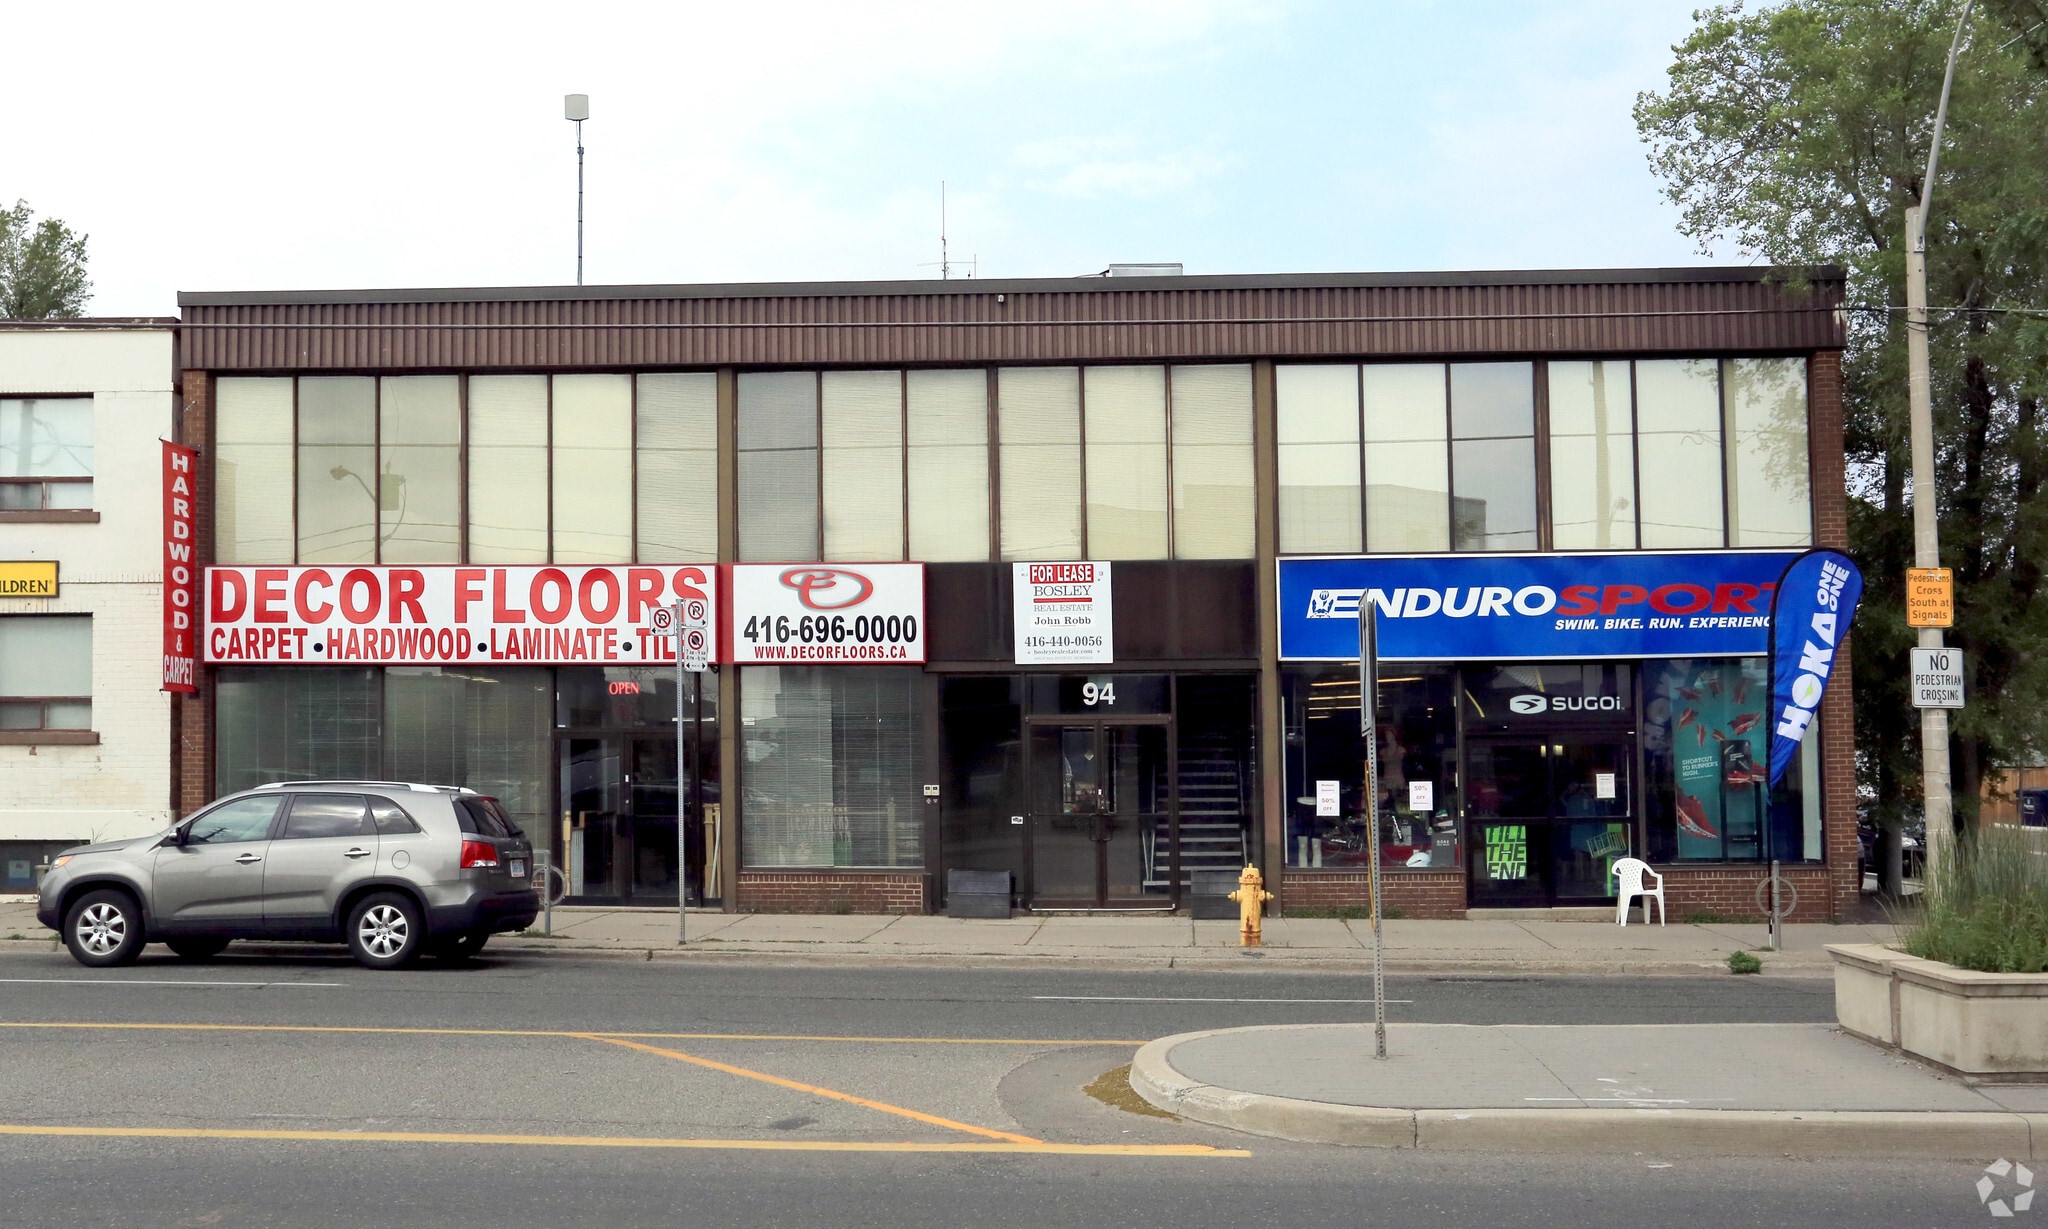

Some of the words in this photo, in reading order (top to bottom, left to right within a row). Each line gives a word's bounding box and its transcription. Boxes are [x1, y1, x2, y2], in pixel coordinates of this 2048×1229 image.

[168, 452, 190, 629] HARDWOOD
[1031, 565, 1053, 582] FOR
[1057, 565, 1092, 582] LEASE
[1909, 574, 1950, 583] Pedestrians
[1817, 560, 1838, 605] ONE
[1829, 566, 1850, 611] ONE
[210, 568, 427, 624] DECOR
[454, 567, 707, 624] FLOORS
[1033, 585, 1092, 597] BOSLEY
[1916, 586, 1942, 595] Cross
[1034, 604, 1058, 612] REAL
[1060, 603, 1093, 612] ESTATE
[1910, 598, 1937, 607] South
[1940, 599, 1950, 607] at
[1034, 617, 1060, 625] John
[1064, 616, 1091, 625] Robb
[1912, 610, 1948, 621] Signals
[744, 615, 917, 643] 416-696-0000
[1555, 619, 1599, 630] SWIM.
[1604, 618, 1643, 630] BIKE.
[1649, 617, 1684, 629] RUN.
[211, 627, 307, 660] CARPET
[326, 628, 471, 660] HARDWOOD
[490, 628, 617, 660] LAMINATE
[636, 628, 684, 660] TIL
[1024, 635, 1102, 647] 416-440-0056
[755, 645, 907, 659] WWW.DECORFLOORS.CA
[1929, 655, 1949, 671] NO
[163, 658, 193, 685] CARPET
[1776, 612, 1837, 741] HOKA
[1916, 674, 1962, 686] PEDESTRIAN
[609, 681, 640, 695] OPEN
[1082, 682, 1115, 705] 94
[1921, 689, 1959, 701] CROSSING
[1682, 756, 1713, 766] SHORTCUT
[1486, 843, 1527, 861] THE
[1487, 862, 1527, 880] END
